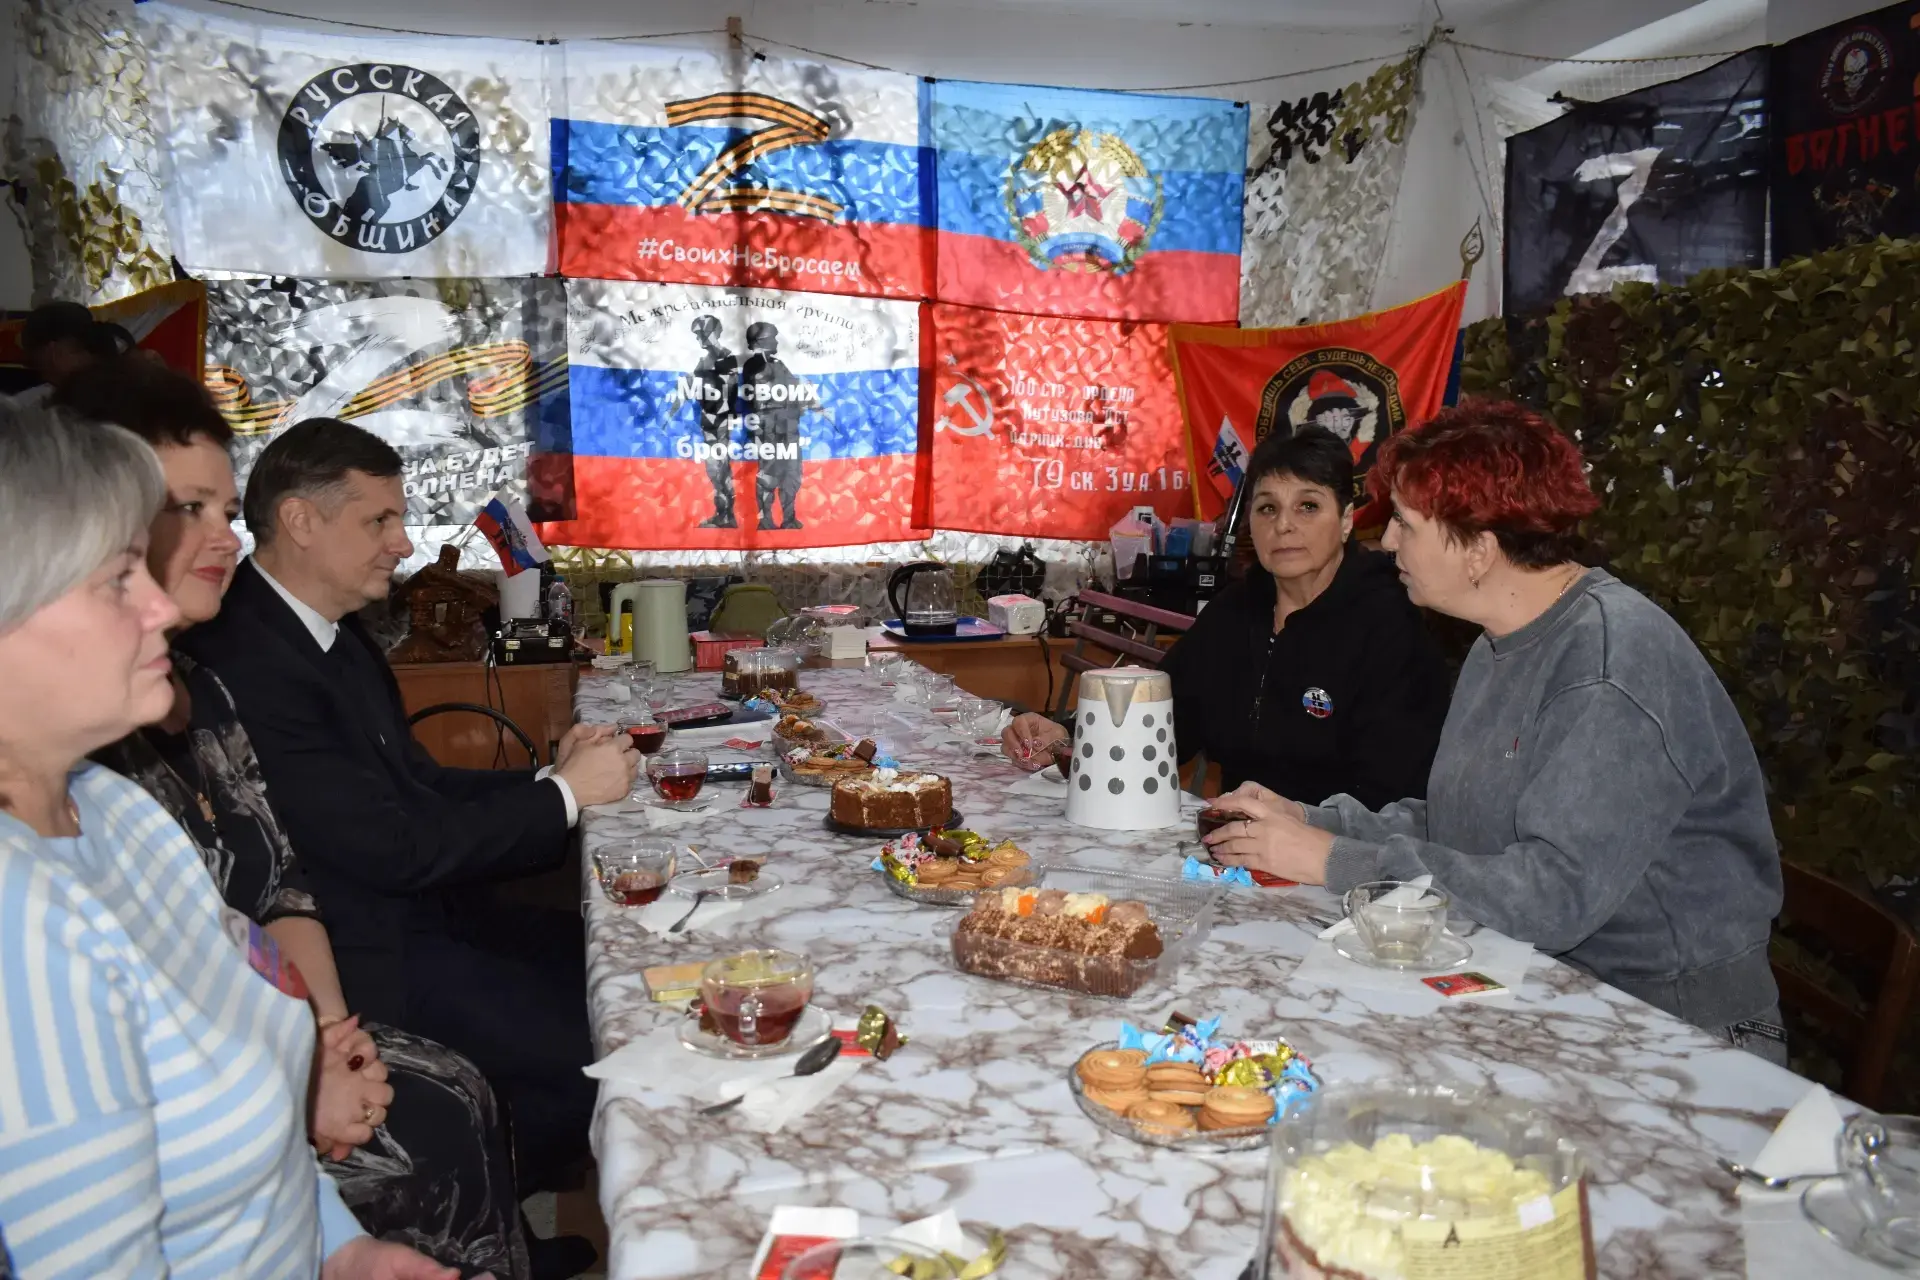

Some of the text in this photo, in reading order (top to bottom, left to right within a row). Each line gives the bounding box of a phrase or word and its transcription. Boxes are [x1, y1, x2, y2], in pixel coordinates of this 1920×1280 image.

[290, 65, 471, 129] РУССКАЯ
[1785, 101, 1920, 176] ВАГНЕ
[664, 92, 845, 228] Z
[303, 192, 463, 250] ОБЩИНА
[1563, 147, 1664, 297] Z
[638, 238, 862, 278] #СвоихНеБросаем
[1283, 356, 1312, 379] СЕБЯ
[1318, 350, 1366, 365] БУДЕШЬ
[738, 383, 821, 402] своих
[727, 412, 760, 431] не
[446, 440, 536, 472] БУДЕТ
[1031, 458, 1064, 489] 79
[403, 465, 514, 498] ОЛНЕНА
